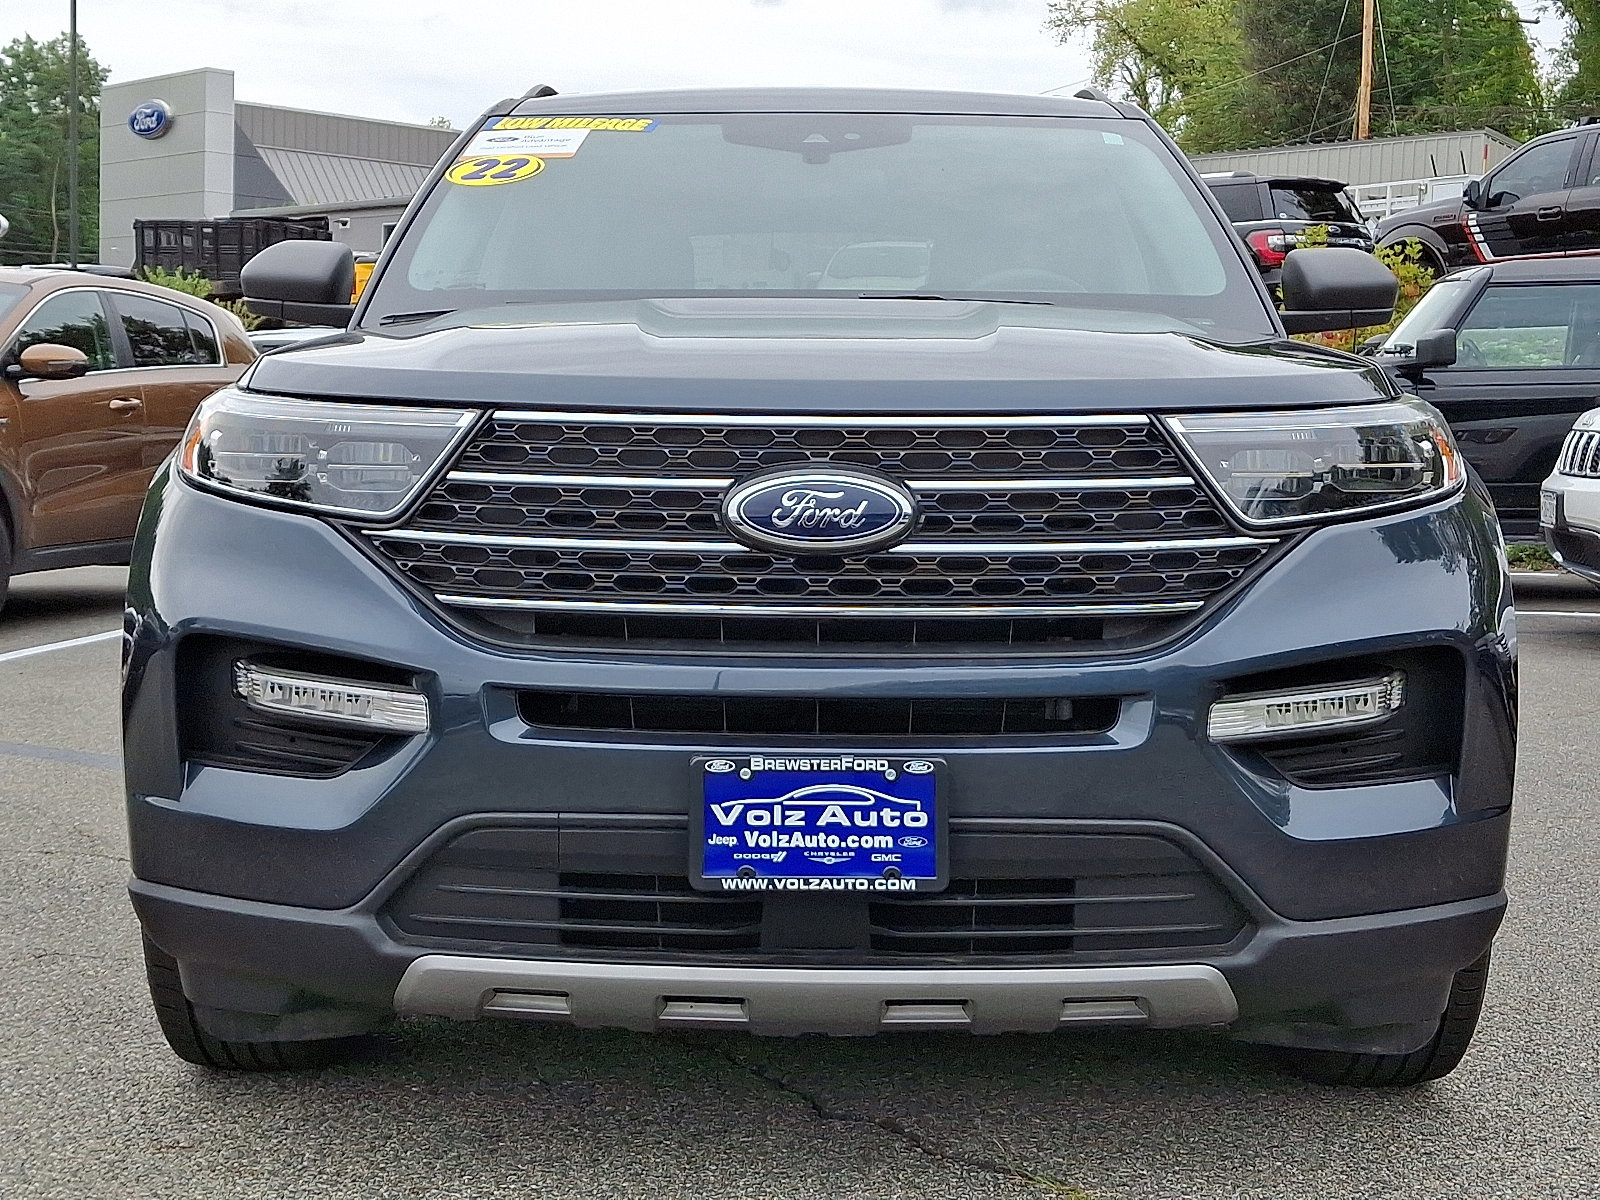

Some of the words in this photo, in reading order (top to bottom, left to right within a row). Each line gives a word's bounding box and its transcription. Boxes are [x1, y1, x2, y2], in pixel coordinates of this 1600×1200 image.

[492, 117, 553, 130] LOW
[544, 117, 653, 131] MILEAGE
[460, 159, 530, 180] 22
[772, 489, 868, 528] Ford
[710, 804, 806, 826] Volz
[816, 805, 928, 827] Auto
[707, 833, 738, 847] Jeep
[744, 830, 894, 848] VolzAuto.com
[871, 853, 903, 862] GMC
[721, 878, 916, 890] WWW.VOLZAUTO.COM
